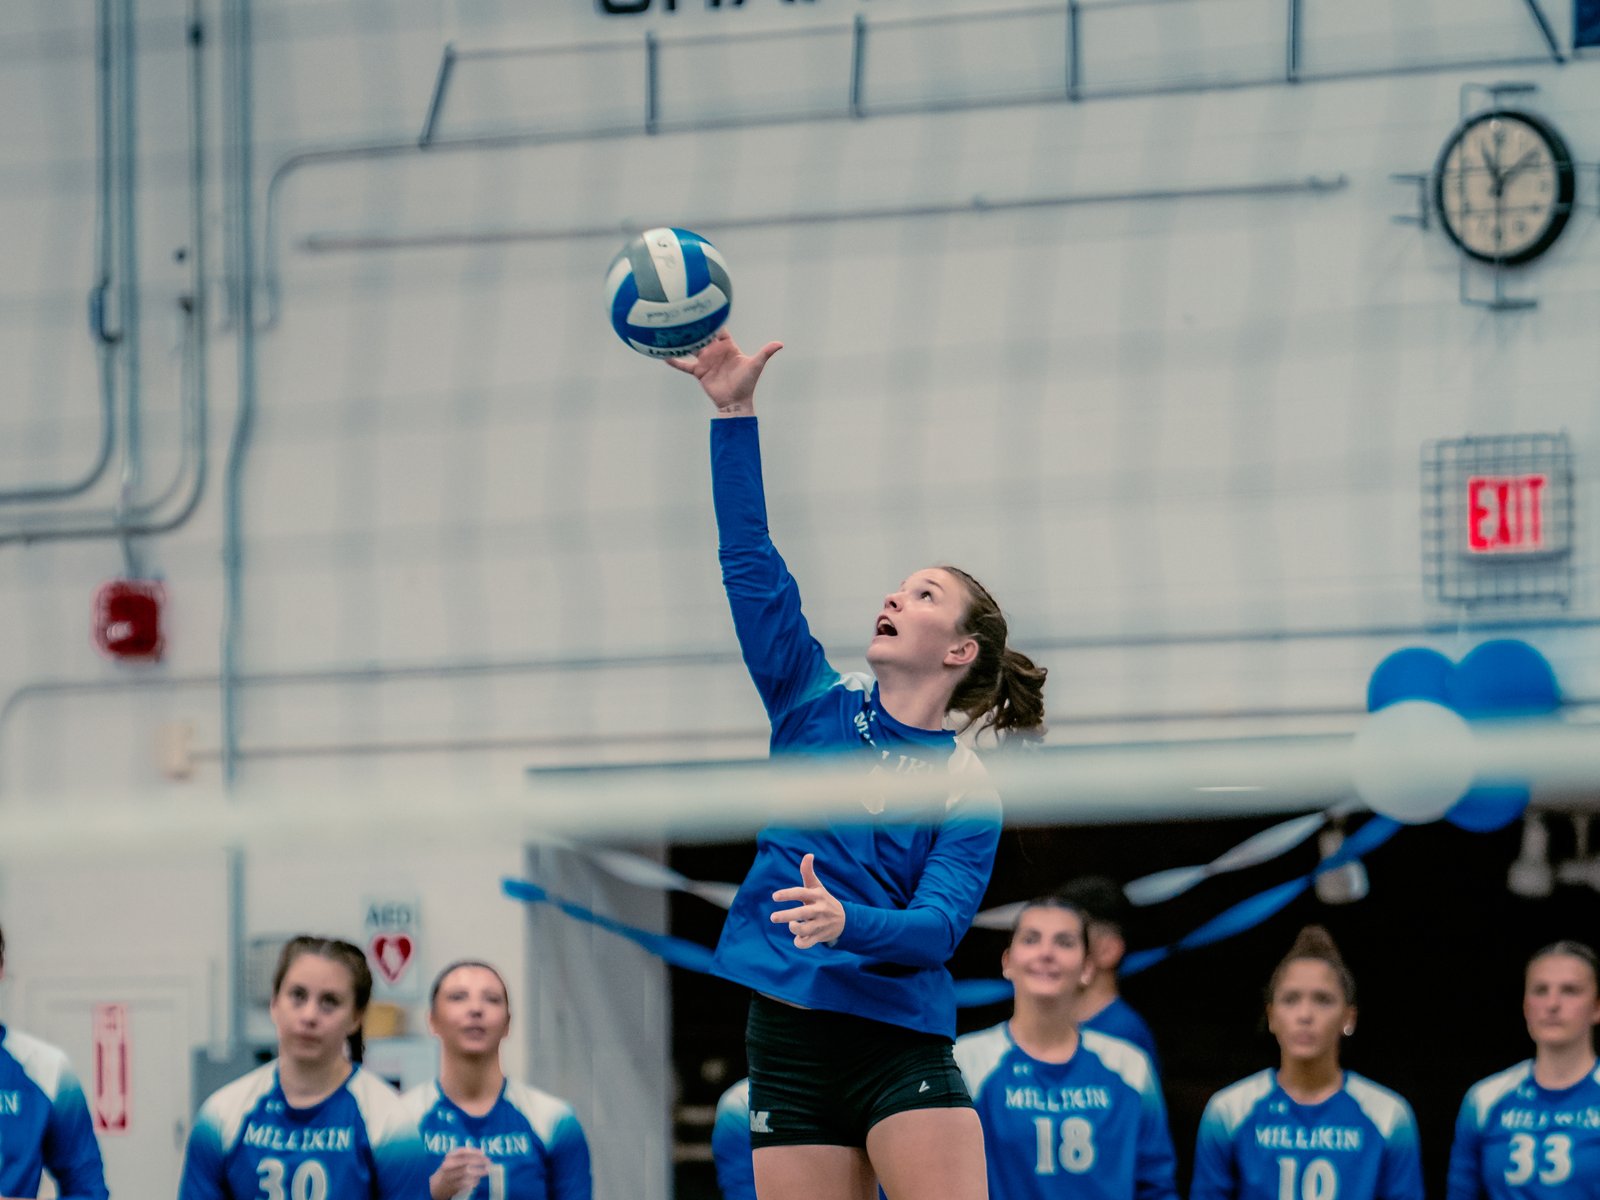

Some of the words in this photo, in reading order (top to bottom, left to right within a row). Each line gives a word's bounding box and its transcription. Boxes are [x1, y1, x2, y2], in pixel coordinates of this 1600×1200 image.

[1468, 476, 1546, 552] EXIT
[1005, 1086, 1110, 1113] MILLIKIN
[243, 1121, 353, 1151] MILLIKIN
[1033, 1116, 1096, 1174] 18
[1256, 1125, 1361, 1151] MILLIKIN
[1504, 1132, 1574, 1186] 33
